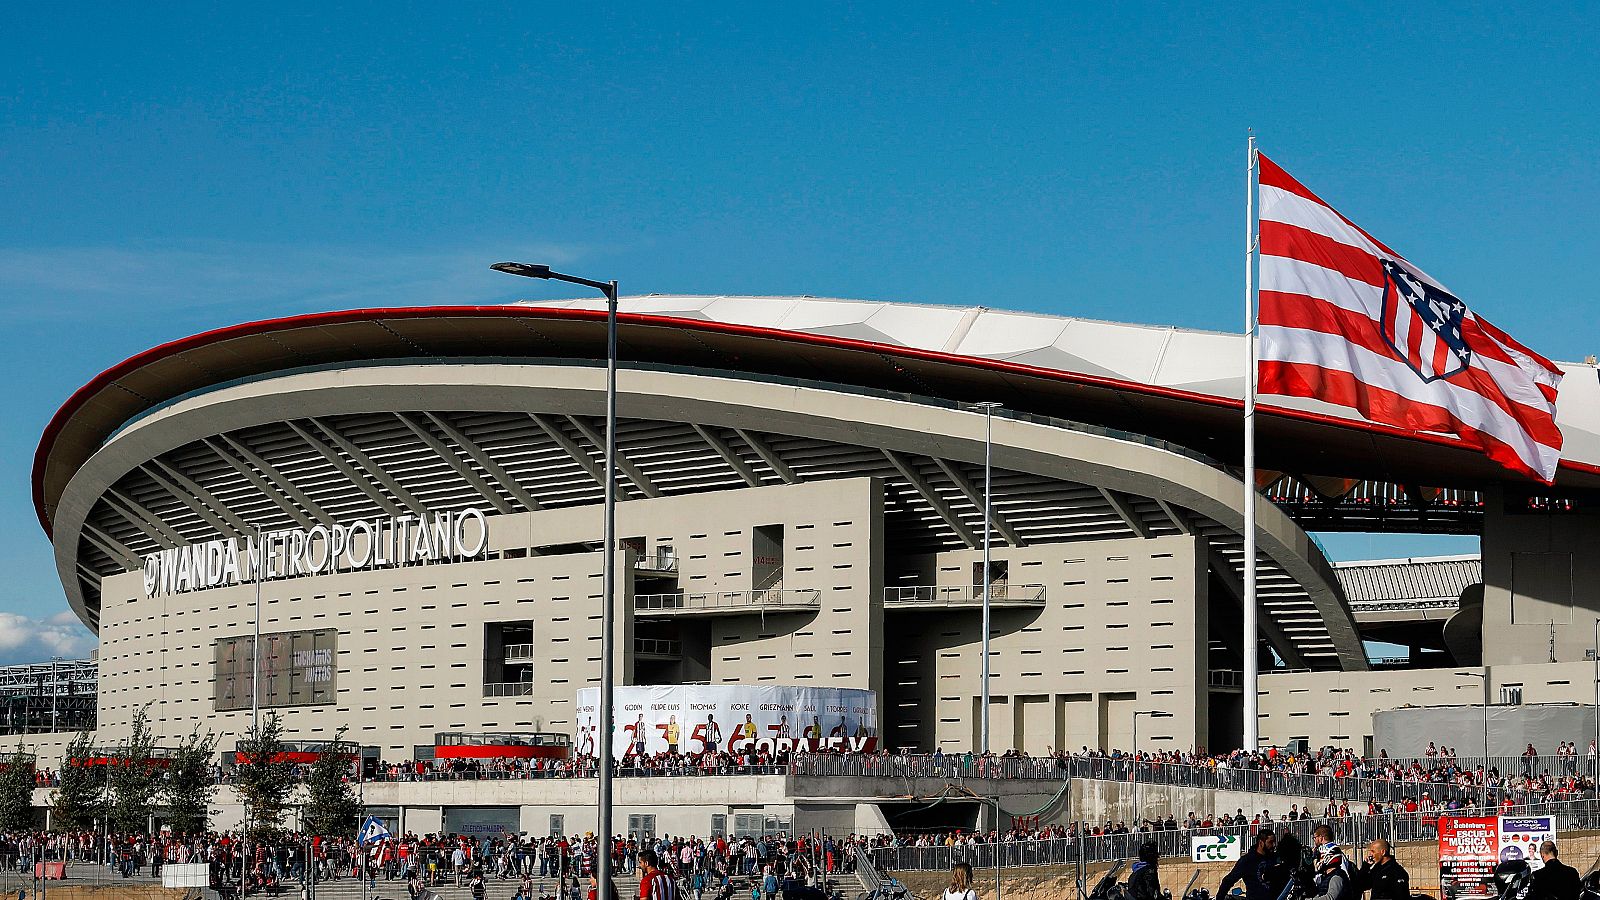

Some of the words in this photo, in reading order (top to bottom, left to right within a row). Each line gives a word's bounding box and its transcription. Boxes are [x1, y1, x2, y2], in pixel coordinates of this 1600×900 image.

[160, 538, 241, 592] WANDA
[247, 507, 489, 581] METROPOLITANO
[294, 648, 332, 666] LUCHAMOS
[304, 666, 331, 683] JUNTOS
[759, 703, 794, 711] GRIEZMANN
[1456, 830, 1495, 838] ESCUELA
[1197, 844, 1227, 860] FCC
[1457, 845, 1491, 853] DANZA
